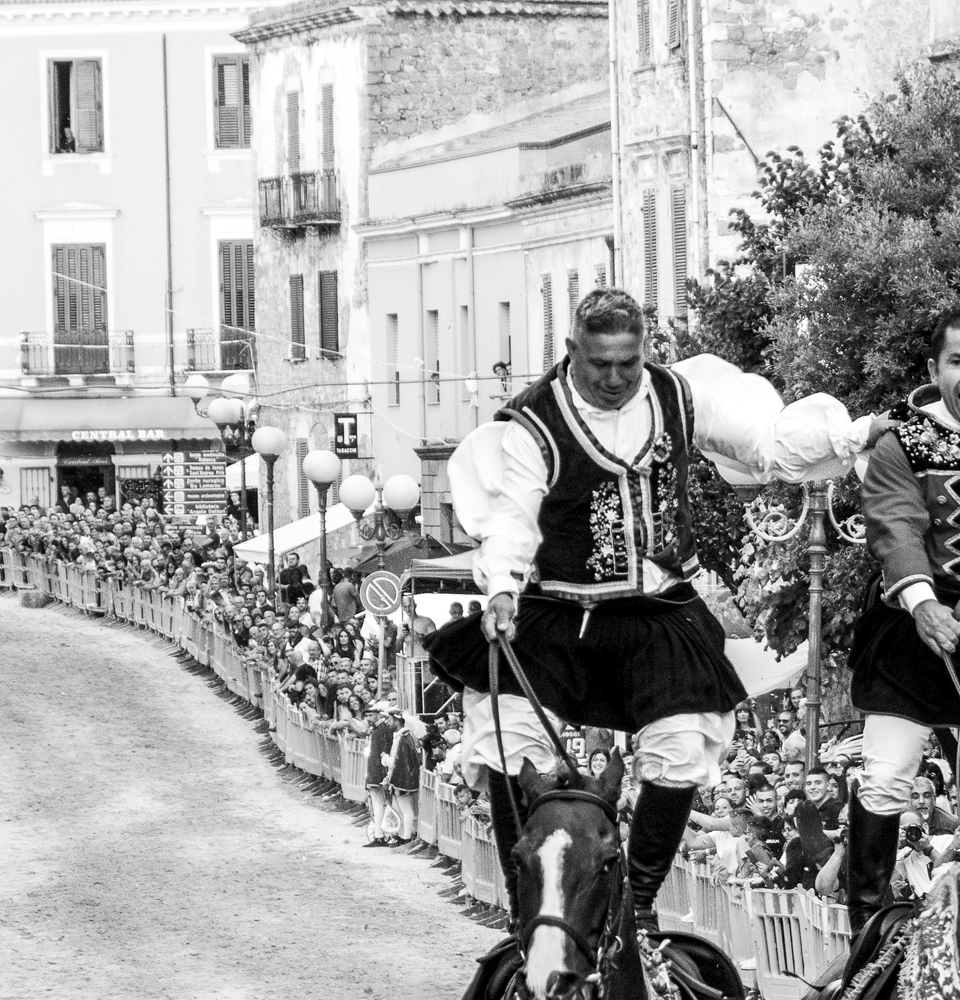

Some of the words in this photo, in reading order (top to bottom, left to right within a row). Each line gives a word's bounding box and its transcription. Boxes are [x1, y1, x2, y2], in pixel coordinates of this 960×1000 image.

[71, 430, 134, 440] CENTRAL
[137, 429, 165, 439] BAR
[337, 417, 354, 445] T
[566, 737, 586, 758] 19
